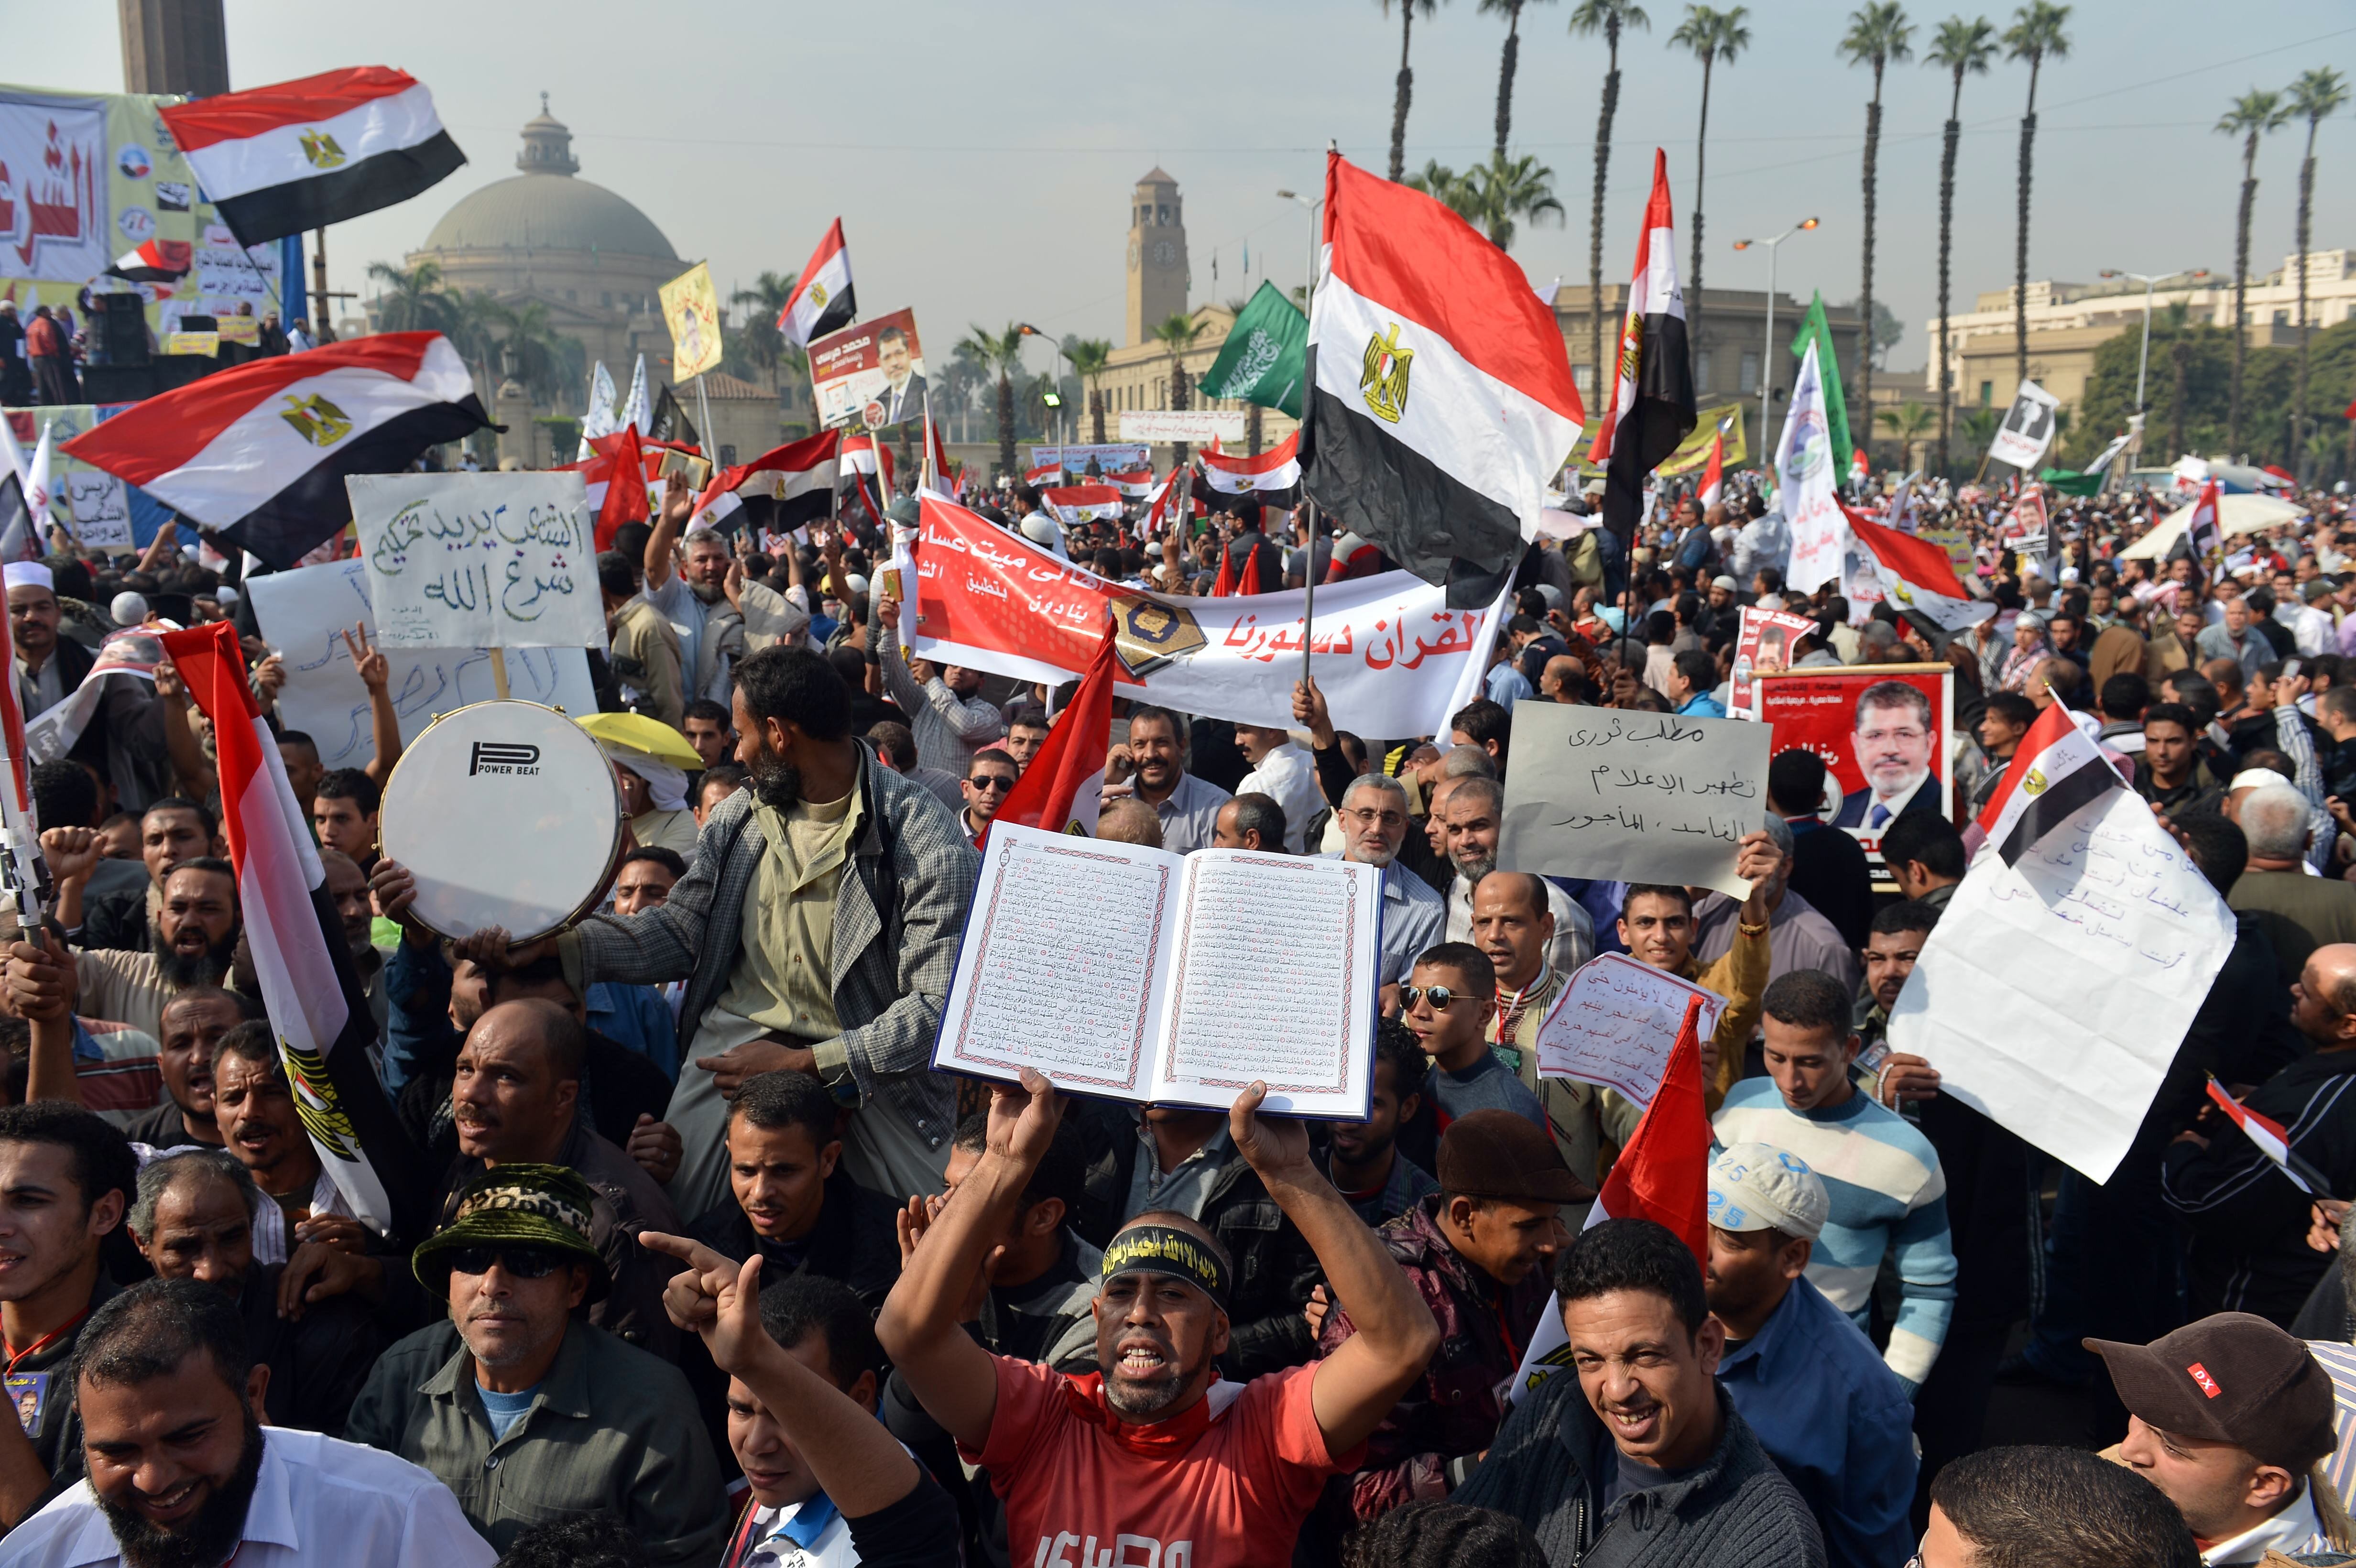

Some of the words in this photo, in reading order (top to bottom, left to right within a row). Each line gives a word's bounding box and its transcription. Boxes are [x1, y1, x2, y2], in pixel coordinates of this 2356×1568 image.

[373, 499, 429, 576] تحكيم
[427, 508, 497, 551] يريد
[495, 502, 583, 556] الشعب
[970, 540, 1027, 568] ميت
[425, 563, 492, 616] الله
[966, 571, 1008, 602] بتطبيق
[1028, 594, 1088, 623] ينادون
[1771, 612, 1809, 630] محمد
[1627, 719, 1704, 747] مطلب
[479, 765, 512, 774] POWER
[517, 767, 540, 776] BEAT
[1692, 771, 1756, 798] تطهير
[1717, 1158, 1750, 1183] 25
[1707, 1188, 1747, 1230] 25
[1127, 1236, 1161, 1258] محمد
[1164, 1234, 1184, 1263] الله
[2193, 1370, 2215, 1391] DX
